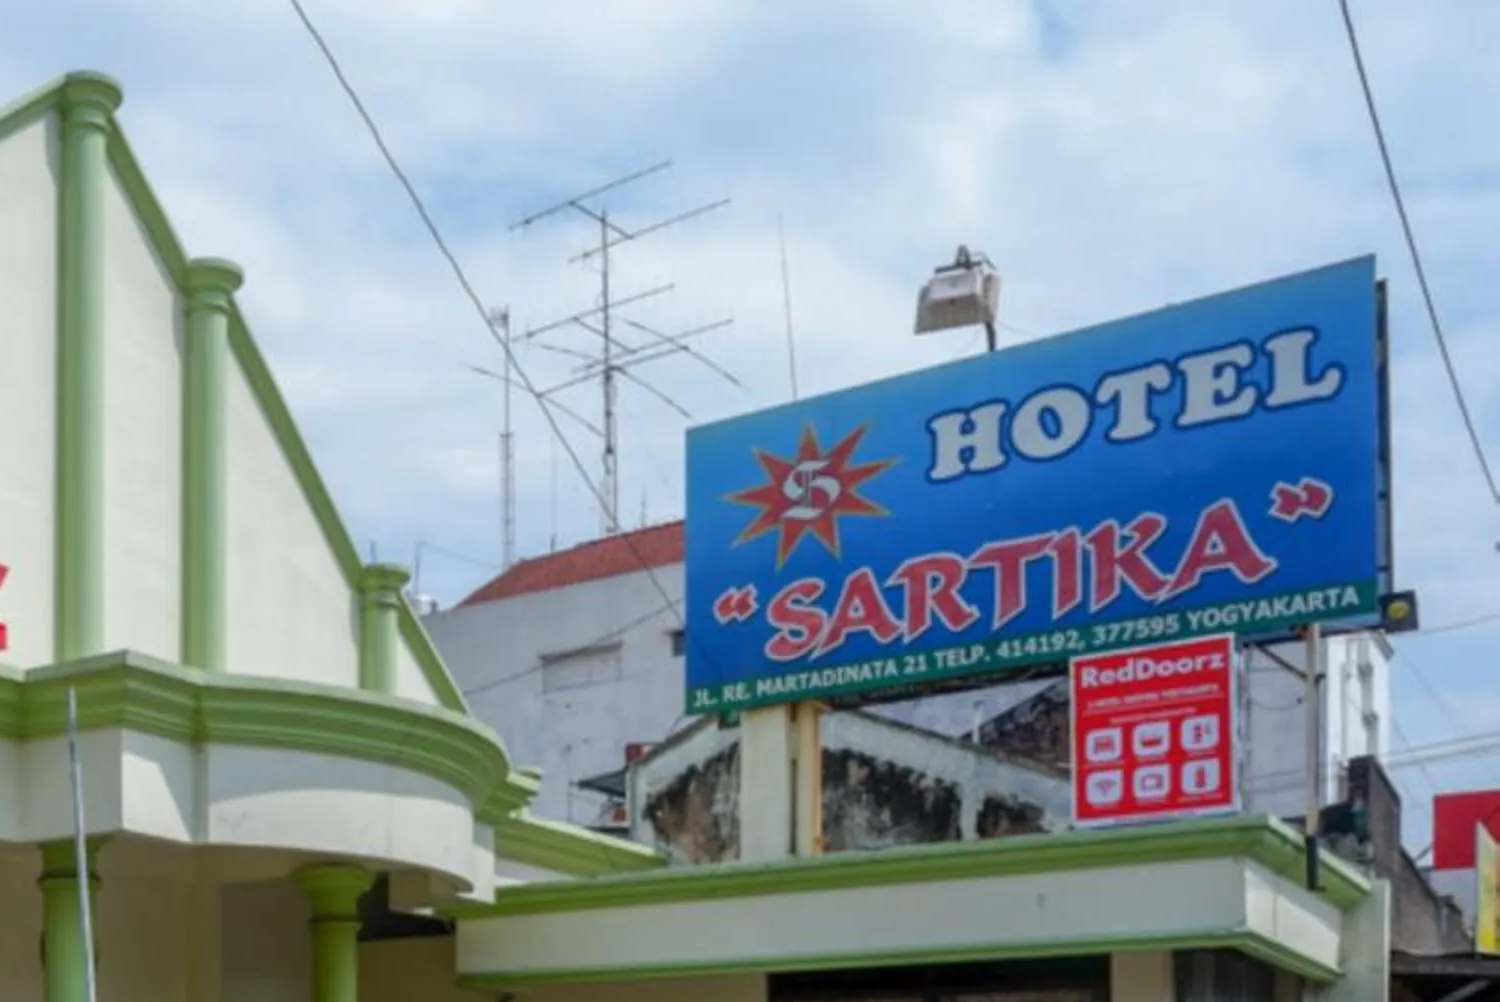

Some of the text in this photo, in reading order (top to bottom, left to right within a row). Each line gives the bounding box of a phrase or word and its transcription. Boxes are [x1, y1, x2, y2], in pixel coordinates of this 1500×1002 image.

[926, 327, 1345, 481] HOTEL
[756, 659, 898, 697] MARTADINATA
[903, 654, 928, 675] 21
[935, 645, 991, 669] TELP.
[1092, 614, 1180, 647] 377595
[1186, 586, 1360, 631] YOGYAKARTA
[1080, 653, 1225, 688] RedDoorz
